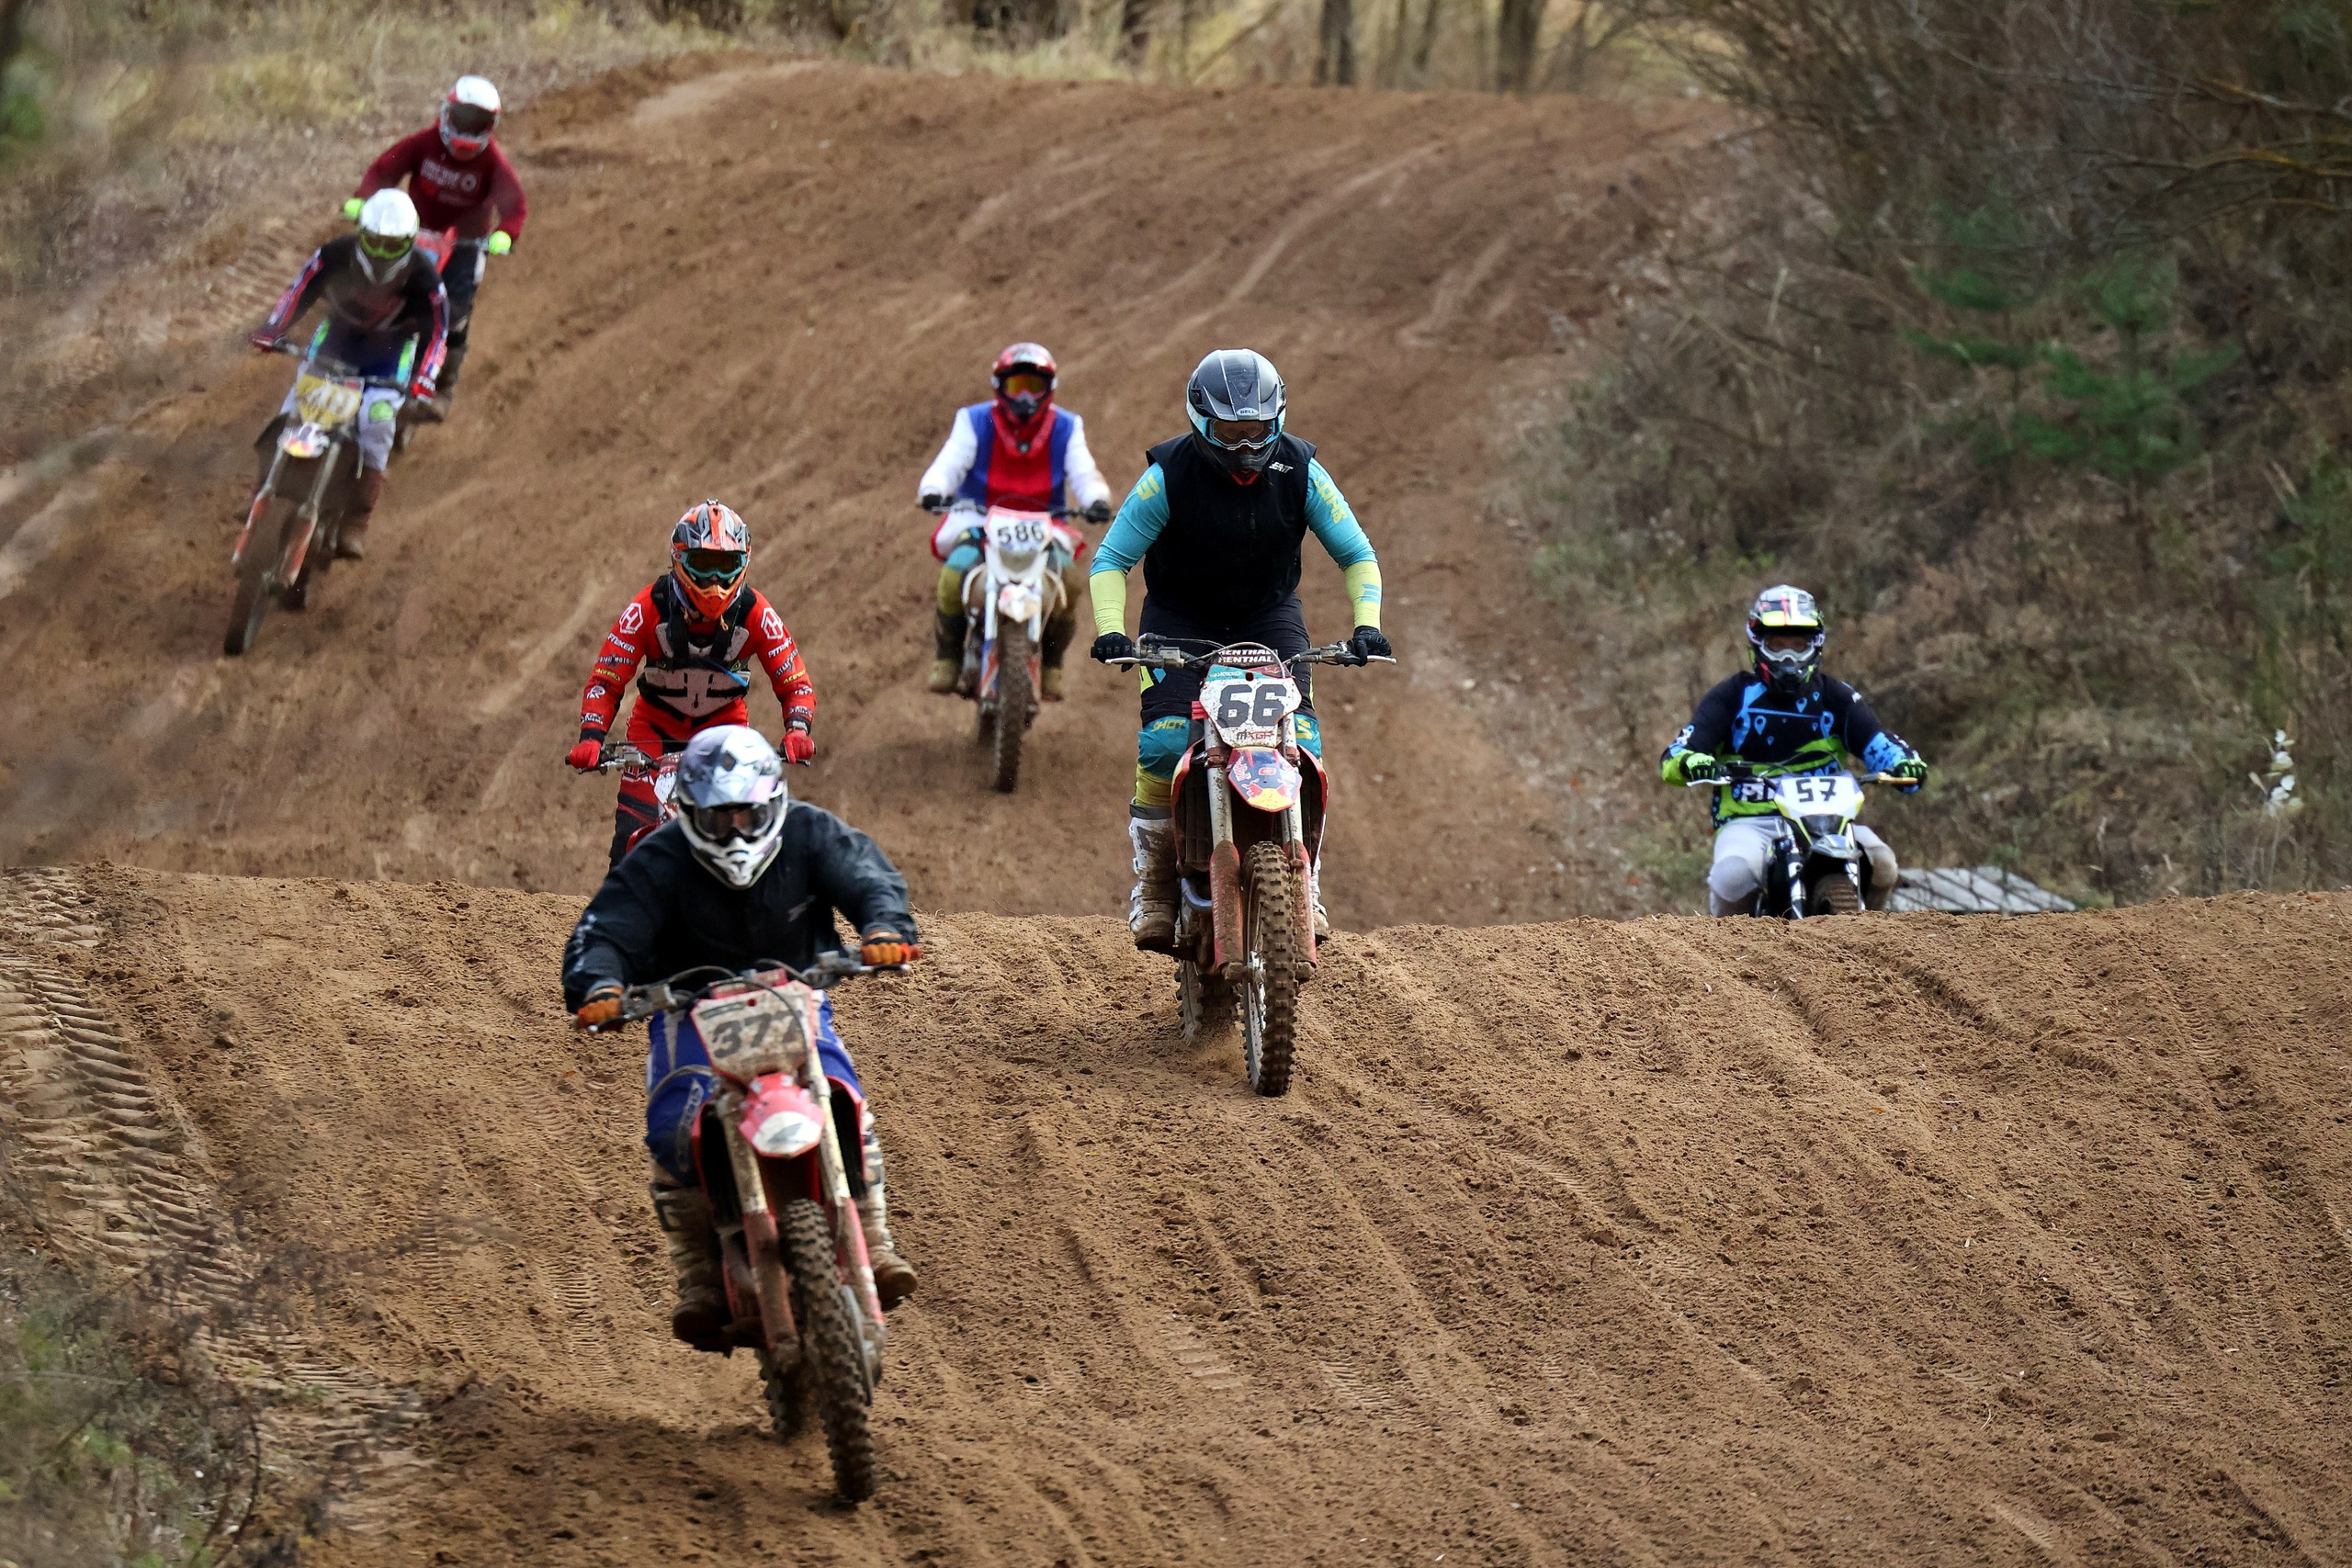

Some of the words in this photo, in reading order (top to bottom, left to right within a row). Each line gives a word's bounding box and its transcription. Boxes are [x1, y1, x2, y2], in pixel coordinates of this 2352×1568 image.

[998, 521, 1045, 545] 586
[1217, 683, 1287, 728] 66
[1795, 777, 1837, 803] 57
